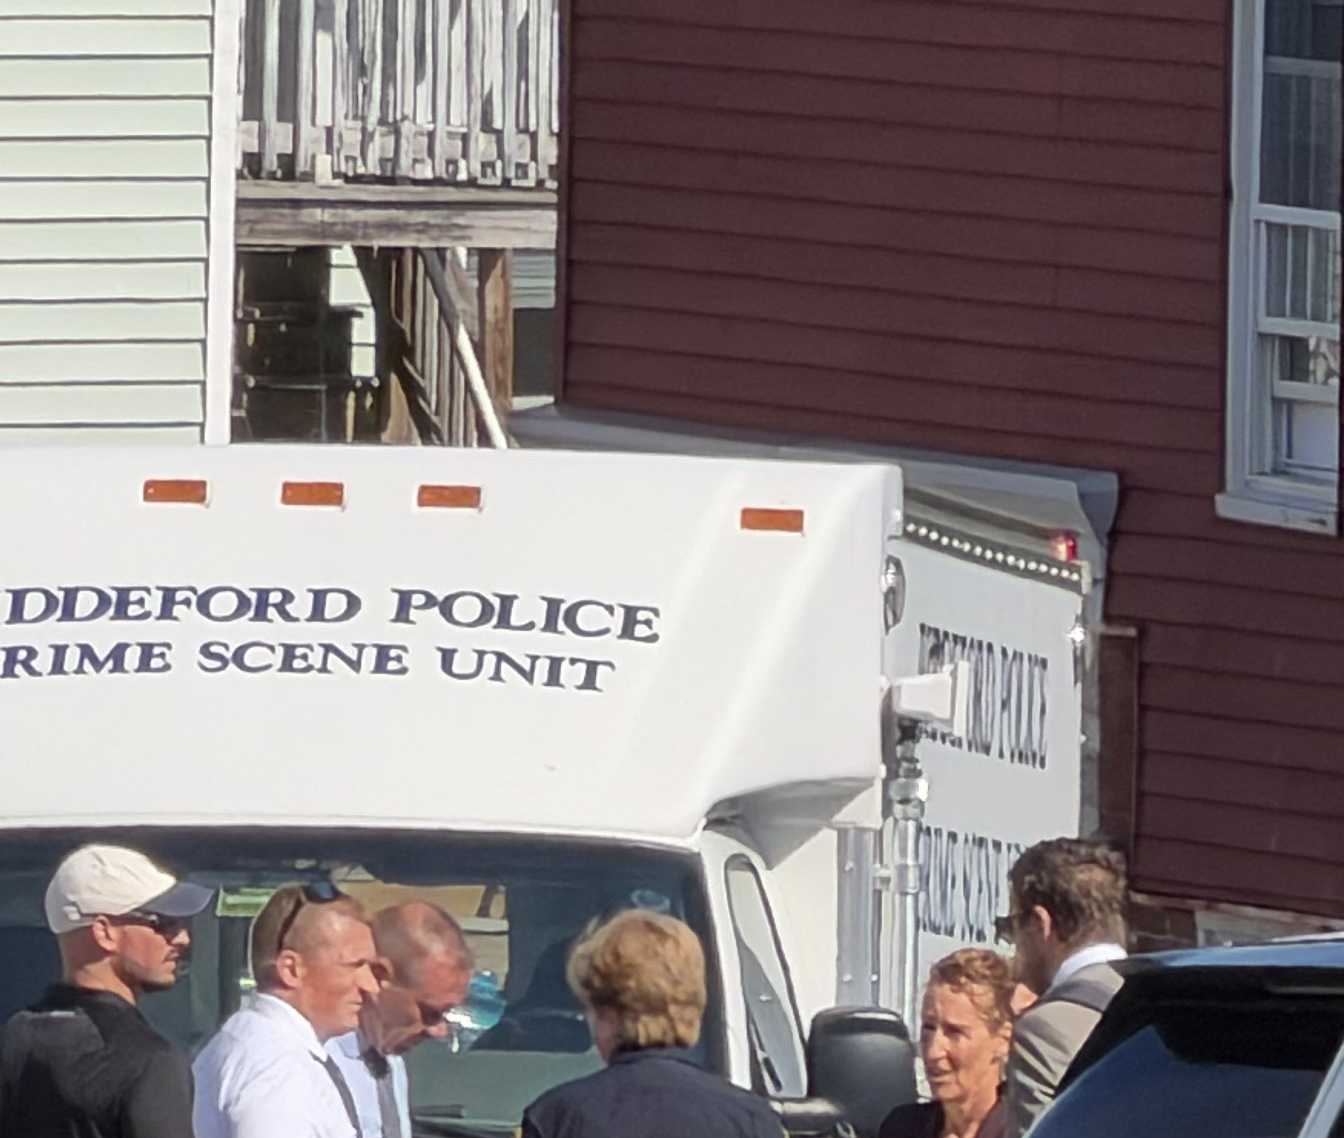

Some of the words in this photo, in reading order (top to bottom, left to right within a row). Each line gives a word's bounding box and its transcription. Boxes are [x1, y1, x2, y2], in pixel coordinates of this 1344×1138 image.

[389, 587, 662, 644] POLICE
[197, 640, 409, 676] SCENE
[436, 646, 617, 692] UNIT
